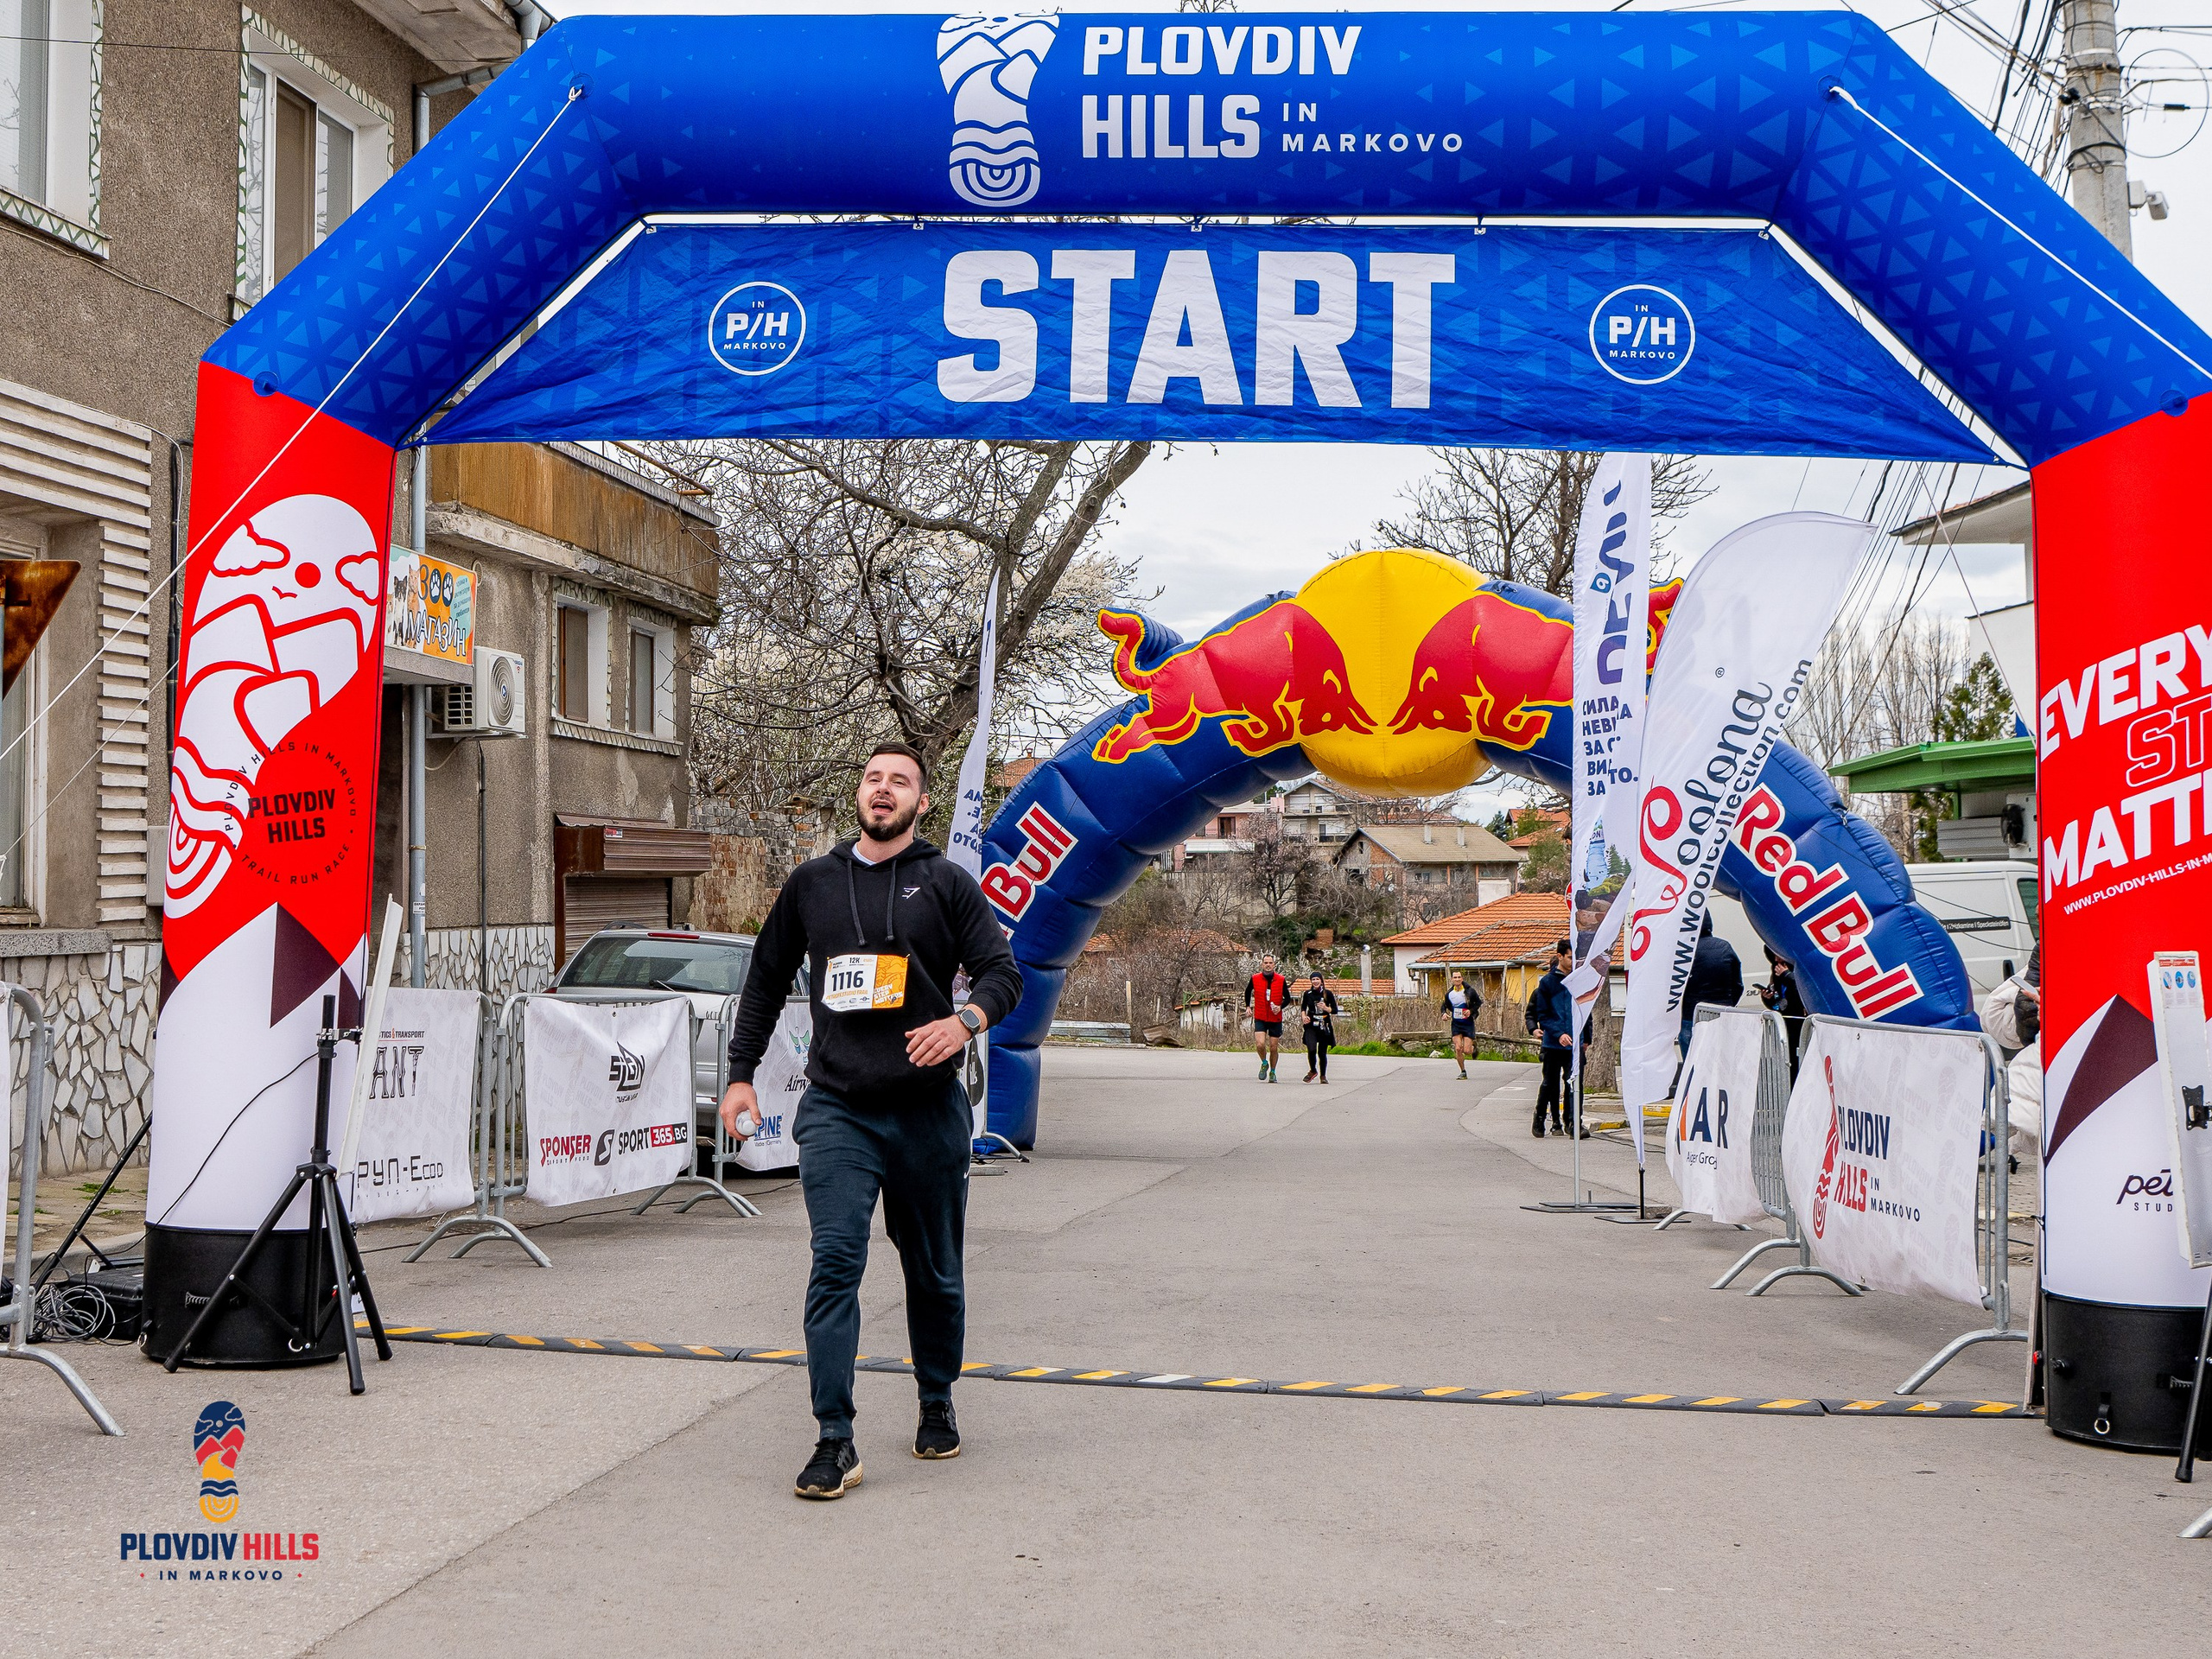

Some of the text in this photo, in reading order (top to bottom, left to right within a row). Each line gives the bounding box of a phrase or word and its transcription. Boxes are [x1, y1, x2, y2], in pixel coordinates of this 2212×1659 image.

[1082, 25, 1363, 76] PLOVDIV
[1082, 94, 1261, 159] HILLS
[1282, 102, 1318, 123] IN
[1282, 133, 1464, 153] MARKOVO
[726, 312, 790, 340] P/H
[937, 249, 1456, 410] START
[1609, 316, 1675, 347] P/H
[1609, 350, 1675, 359] MARKOVO
[407, 609, 467, 657] МАГАЗИН
[224, 741, 357, 831] PLOVDIV HILLS IN MARKOVO
[247, 788, 336, 819] PLOVDIV
[267, 817, 327, 844] HILLS
[2044, 770, 2212, 905] MATT
[241, 844, 350, 885] TRAIL RUN RACE
[981, 806, 1074, 918] Bull
[1732, 788, 1918, 1019] Red Bull
[832, 970, 864, 992] 1116
[540, 1134, 592, 1167] SPONSER
[1838, 1105, 1891, 1160] PLOVDIV
[1834, 1160, 1868, 1212] HILLS
[1870, 1176, 1880, 1191] IN
[1870, 1197, 1921, 1222] MARKOVO
